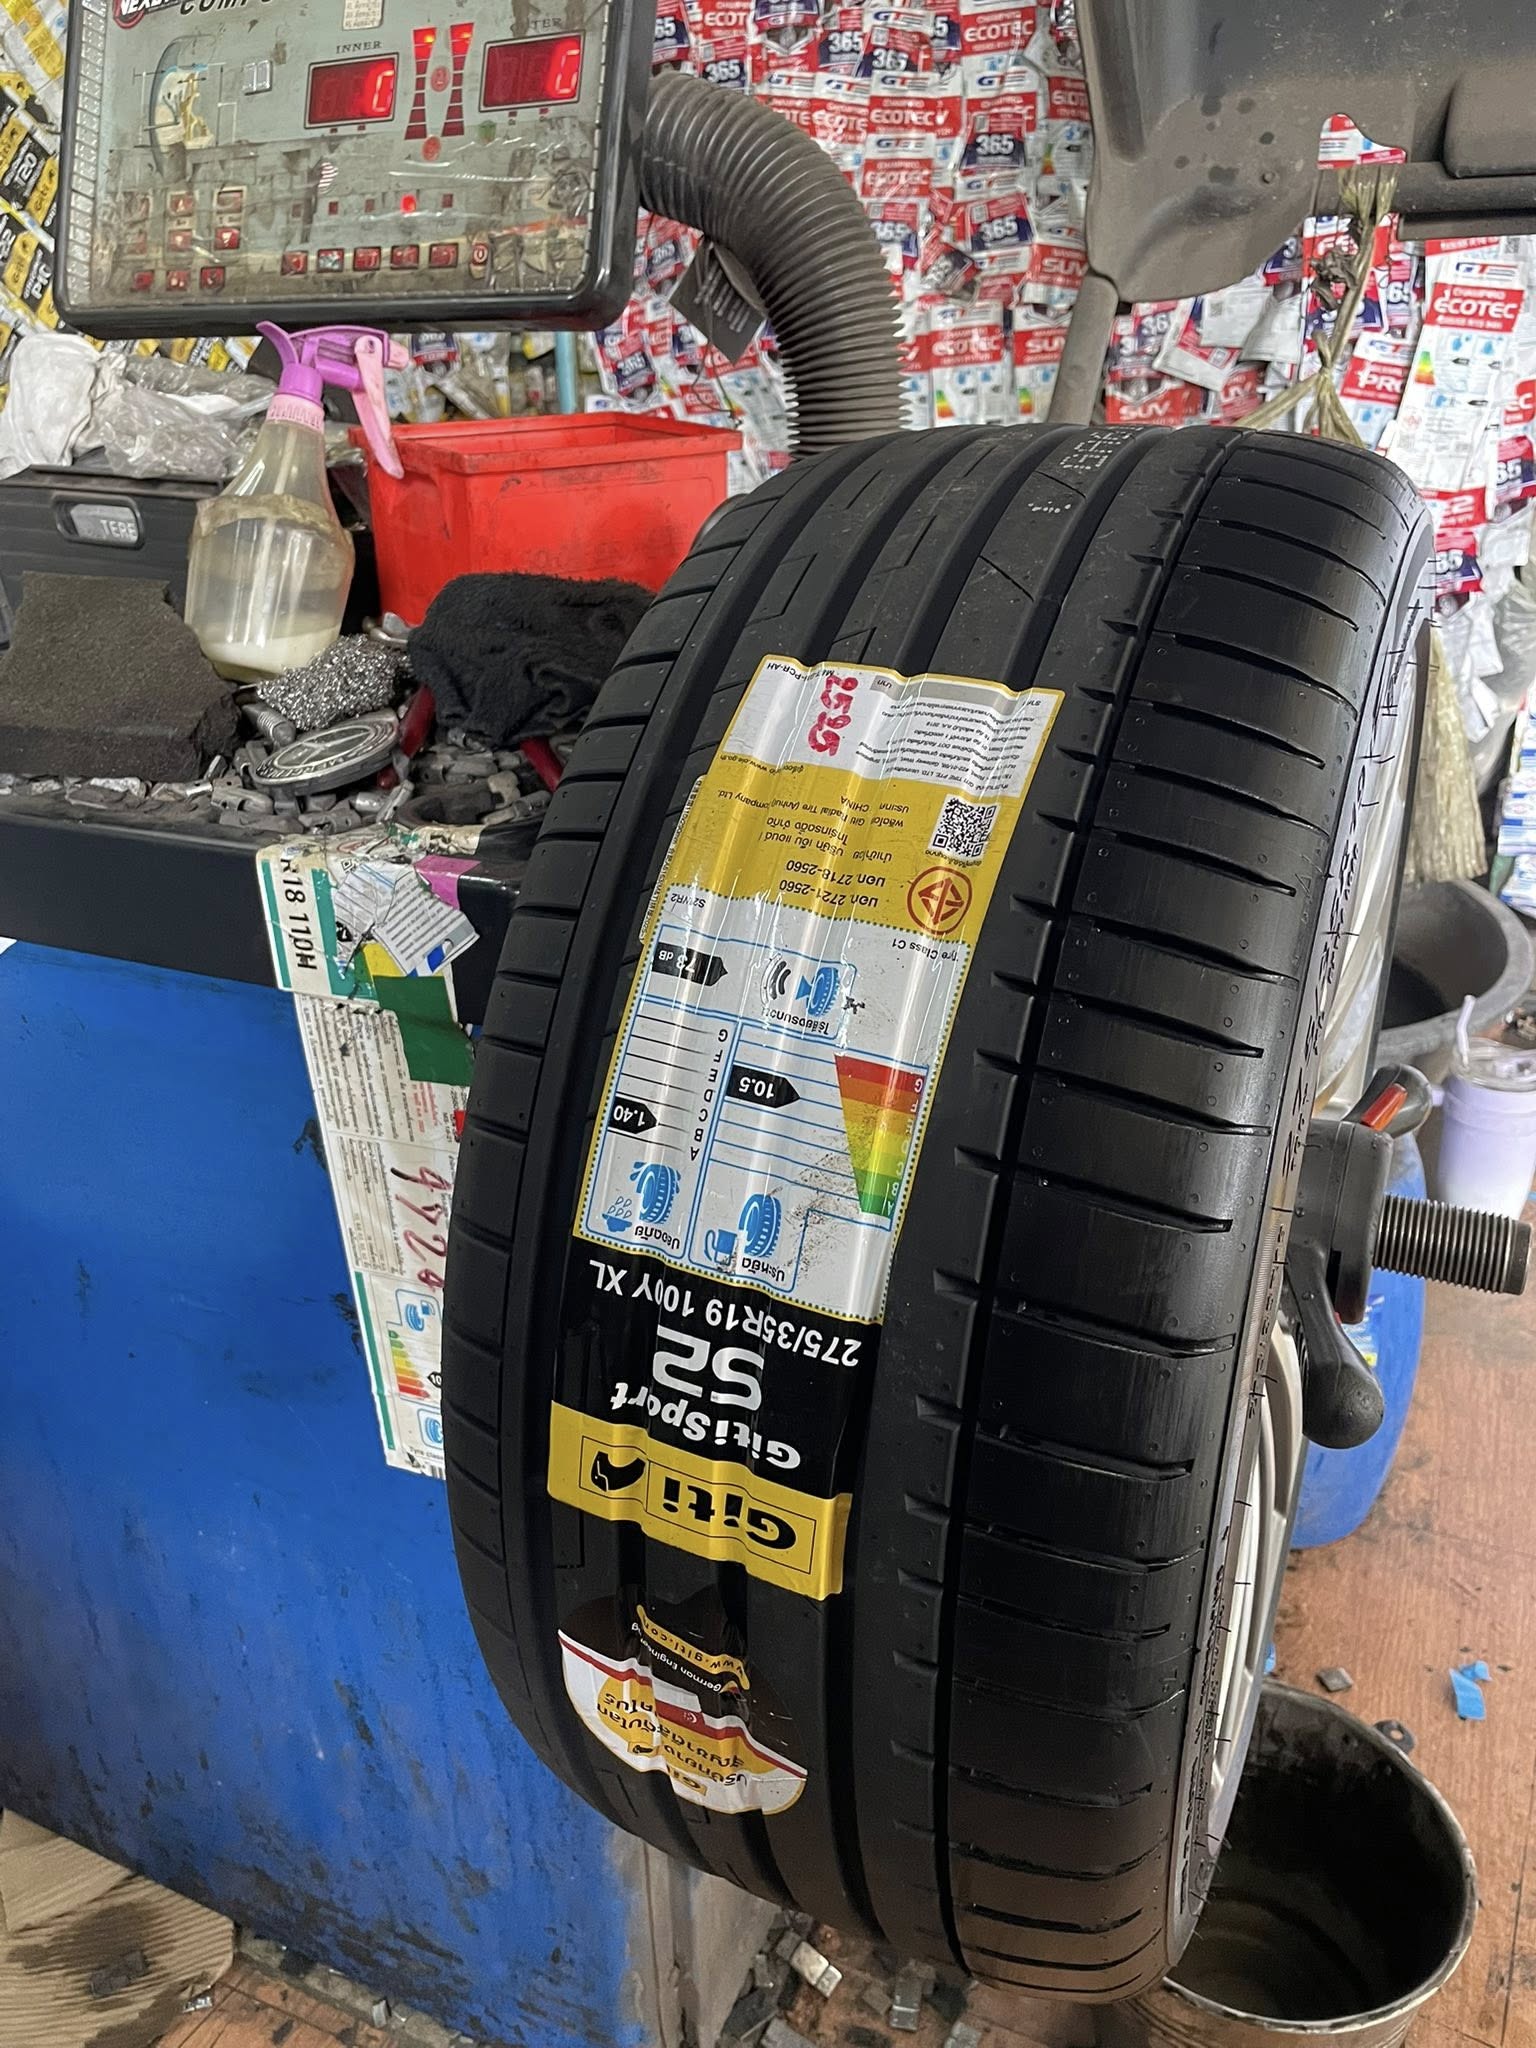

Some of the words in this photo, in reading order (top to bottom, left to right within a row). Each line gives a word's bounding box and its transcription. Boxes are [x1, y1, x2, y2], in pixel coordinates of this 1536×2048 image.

[655, 17, 676, 39] 65
[964, 20, 1034, 42] ECOTEC
[335, 40, 383, 54] INNER
[828, 31, 863, 53] 365
[872, 48, 909, 71] 365
[705, 59, 741, 83] 365
[870, 109, 935, 126] ECOTEC
[976, 135, 1014, 155] 365
[980, 215, 1018, 241] 365
[1042, 258, 1089, 277] SUV
[1434, 297, 1518, 319] ECOTEC
[1120, 402, 1171, 421] SUV
[808, 675, 859, 757] 2595
[717, 788, 732, 800] Ltd.
[731, 790, 770, 811] ompany
[841, 795, 870, 813] CHINA
[802, 803, 818, 814] Tire
[786, 860, 854, 886] 2718-2560
[779, 878, 850, 907] 2721-2560
[289, 912, 318, 970] 110H
[891, 938, 906, 950] C1
[909, 940, 938, 960] Class
[658, 949, 674, 962] dB
[941, 949, 959, 963] Tyre
[717, 1028, 728, 1043] G
[713, 1049, 722, 1062] F
[707, 1069, 717, 1083] E
[913, 1079, 922, 1093] G
[704, 1088, 713, 1102] D
[738, 1075, 775, 1099] 10.5
[613, 1103, 646, 1126] 1.40
[698, 1108, 708, 1121] C
[910, 1102, 918, 1113] F
[694, 1128, 703, 1142] B
[690, 1147, 700, 1160] A
[890, 1182, 900, 1196] B
[590, 1260, 628, 1296] XL
[741, 1256, 785, 1282] ประหยัด
[631, 1273, 695, 1317] 100Y
[705, 1299, 862, 1368] 275/35R19
[653, 1325, 765, 1411] S2
[610, 1382, 801, 1469] GitiSport
[662, 1476, 798, 1550] Giti
[678, 1665, 721, 1692] German
